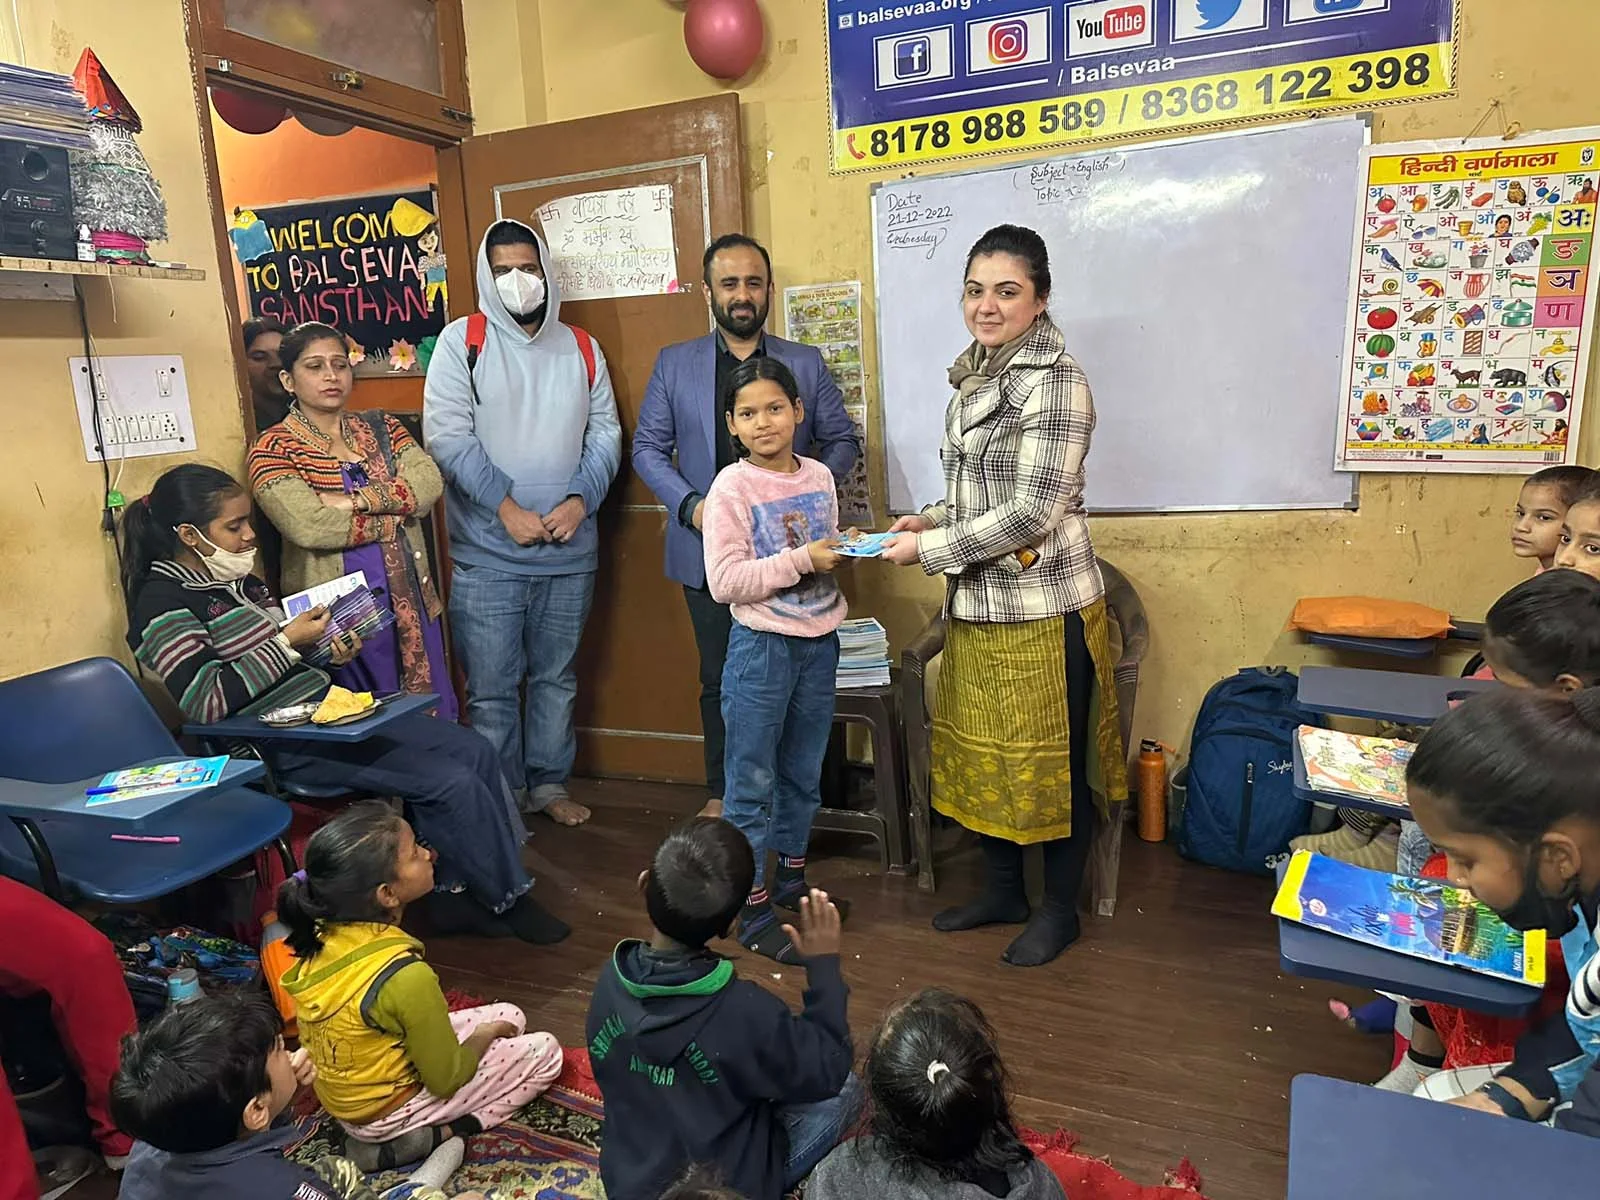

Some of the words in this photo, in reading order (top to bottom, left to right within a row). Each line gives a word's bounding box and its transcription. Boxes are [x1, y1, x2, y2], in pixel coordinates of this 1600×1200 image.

[858, 0, 971, 25] balsevaa.org
[1077, 9, 1144, 39] YouTube
[1071, 55, 1176, 85] Balsevaa
[870, 120, 950, 157] 8178
[962, 109, 1026, 145] 988
[1038, 98, 1106, 134] 589
[1142, 79, 1238, 120] 8368
[1255, 66, 1332, 105] 122
[1349, 52, 1430, 92] 398
[1031, 163, 1068, 185] Subject
[1076, 157, 1109, 180] English
[1400, 155, 1458, 176] हिन्दी
[1463, 151, 1559, 171] वर्णमाला
[1399, 185, 1418, 196] आ
[1432, 184, 1443, 195] इ
[1464, 182, 1475, 199] ई
[1496, 180, 1509, 190] उ
[886, 191, 922, 212] Date
[1439, 213, 1457, 227] ओ
[1477, 210, 1496, 225] औ
[270, 209, 400, 252] WELCOM
[1365, 244, 1380, 255] क
[1408, 243, 1424, 253] ख
[1452, 241, 1464, 250] ग
[1498, 239, 1512, 249] घ
[246, 263, 279, 293] TO
[1362, 274, 1376, 284] च
[1405, 272, 1419, 283] छ
[1449, 271, 1464, 280] ज
[260, 286, 428, 328] SANSTHAN
[1402, 303, 1414, 312] ठ
[1544, 303, 1575, 320] ण
[1357, 333, 1368, 343] त
[1444, 331, 1455, 342] द
[1535, 329, 1547, 339] न
[1354, 362, 1365, 371] प
[1397, 361, 1412, 371] फ
[1531, 360, 1544, 369] म
[1394, 390, 1403, 399] र
[1438, 390, 1452, 399] ल
[1384, 418, 1397, 428] स
